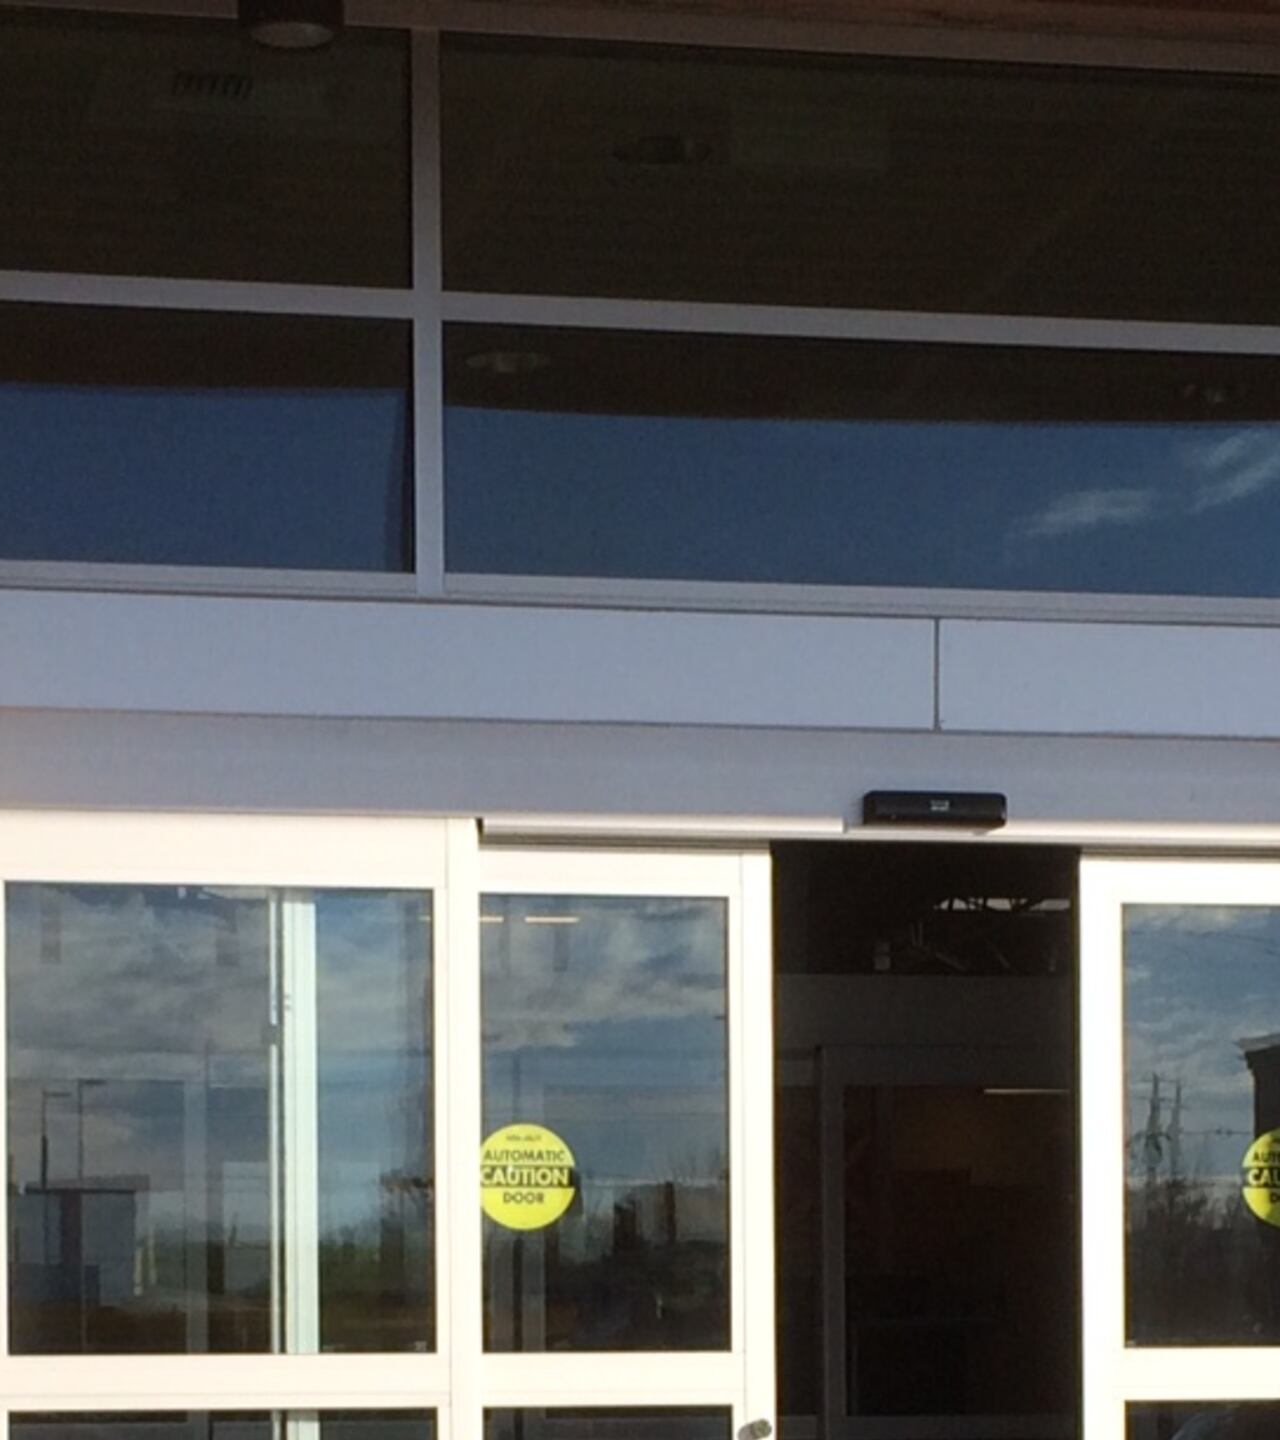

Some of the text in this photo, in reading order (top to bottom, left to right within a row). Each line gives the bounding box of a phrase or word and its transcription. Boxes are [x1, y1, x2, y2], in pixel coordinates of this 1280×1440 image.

[484, 1149, 566, 1161] AUTOMATIC
[481, 1168, 569, 1185] CAUTION
[503, 1192, 544, 1203] DOOR
